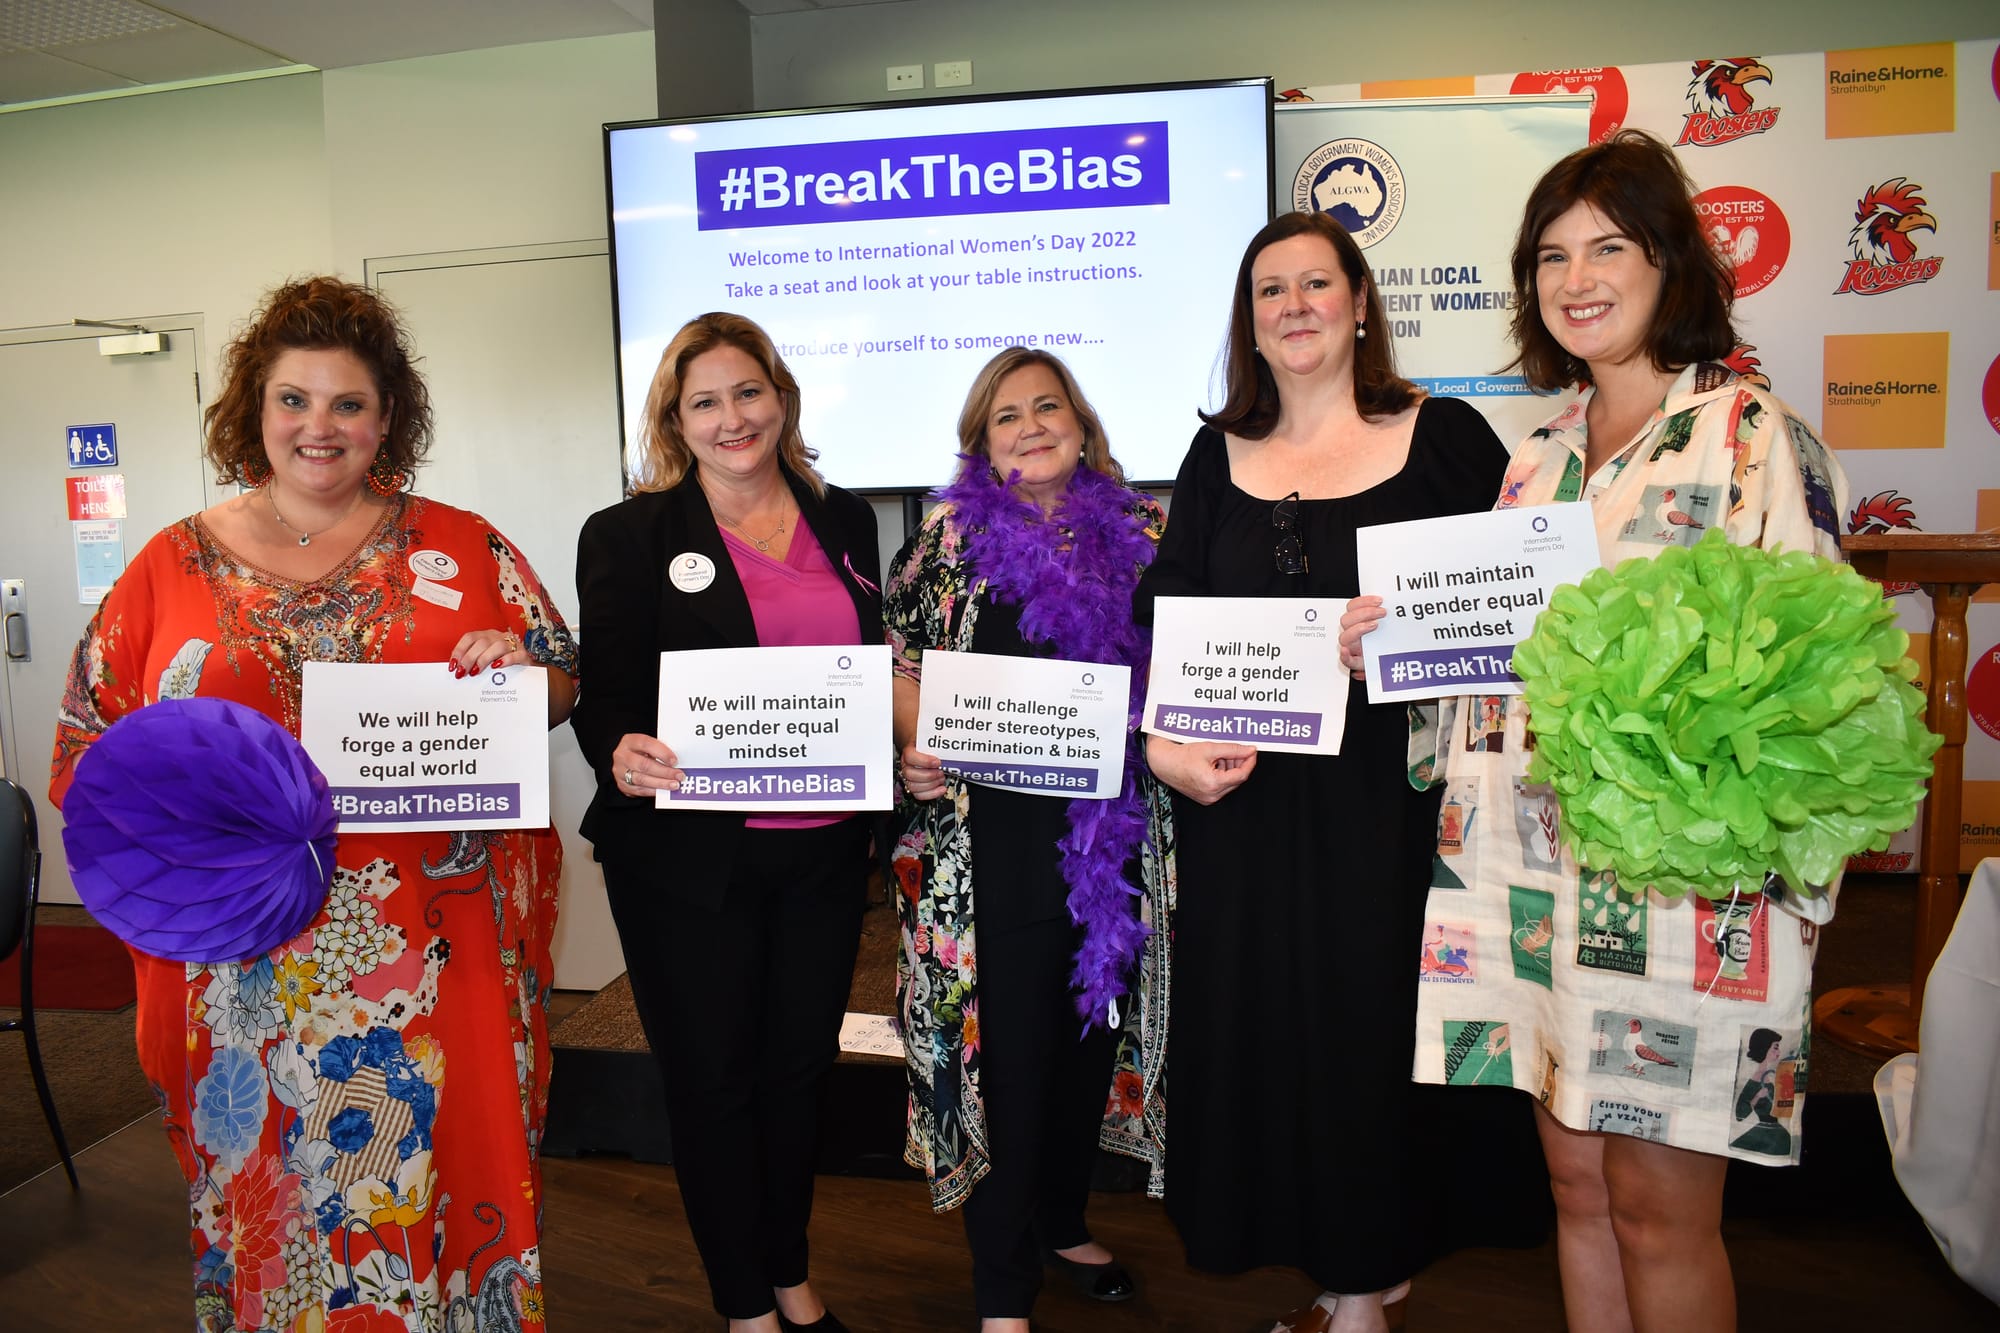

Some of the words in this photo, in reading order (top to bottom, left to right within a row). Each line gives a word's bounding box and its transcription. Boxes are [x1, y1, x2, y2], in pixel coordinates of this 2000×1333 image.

[1564, 76, 1581, 84] EST
[1583, 75, 1603, 83] 1879
[1830, 83, 1886, 95] Strathalbyn
[1672, 106, 1781, 147] Roosters
[1308, 143, 1364, 172] GOVERNMENT
[1364, 146, 1398, 181] WOMEN'S
[719, 146, 1143, 212] #BreakTheBias
[1297, 170, 1313, 196] LOCAL
[1329, 185, 1370, 196] ALGWA
[1374, 181, 1401, 234] ASSOCIATION
[1725, 216, 1742, 224] EST
[1744, 215, 1765, 223] 1879
[728, 250, 809, 267] Welcome
[815, 248, 833, 263] to
[838, 239, 955, 261] International
[1051, 234, 1086, 253] Day
[1091, 231, 1137, 249] 2022
[725, 281, 763, 298] Take
[769, 284, 778, 296] a
[783, 279, 820, 295] seat
[825, 276, 857, 293] and
[863, 273, 901, 290] look
[907, 273, 924, 289] at
[929, 274, 970, 291] your
[976, 268, 1022, 285] table
[1028, 264, 1143, 283] instructions.
[1421, 266, 1482, 286] LOCAL
[1735, 280, 1765, 296] OTBALL
[1762, 264, 1780, 282] CLUB
[1832, 256, 1944, 295] Roosters
[853, 334, 925, 358] yourself
[930, 336, 949, 351] to
[954, 333, 1038, 350] someone
[1434, 382, 1470, 393] Local
[1828, 397, 1881, 407] Strathalbyn
[1523, 535, 1562, 545] International
[1523, 544, 1552, 554] Women's
[1552, 543, 1565, 551] Day
[1396, 575, 1402, 591] I
[1407, 572, 1440, 590] will
[1445, 562, 1535, 587] maintain
[1395, 605, 1406, 618] a
[1412, 597, 1481, 620] gender
[1487, 588, 1544, 612] equal
[1433, 619, 1514, 640] mindset
[1206, 641, 1211, 655] I
[1215, 642, 1242, 656] will
[1247, 643, 1281, 660] help
[1181, 662, 1223, 680] forge
[1228, 668, 1237, 678] a
[1241, 664, 1300, 682] gender
[1391, 656, 1515, 683] #BreakThe
[852, 680, 864, 688] Day
[1194, 686, 1237, 703] equal
[1242, 688, 1289, 703] world
[506, 696, 519, 704] Day
[689, 696, 717, 711] We
[724, 695, 756, 711] will
[763, 694, 846, 711] maintain
[954, 694, 959, 708] I
[964, 696, 991, 711] will
[997, 698, 1079, 721] challenge
[358, 712, 390, 728] We
[397, 711, 429, 727] will
[436, 710, 479, 729] help
[695, 724, 706, 736] a
[712, 719, 781, 740] gender
[786, 718, 839, 738] equal
[934, 716, 993, 733] gender
[997, 721, 1101, 743] stereotypes,
[1163, 711, 1312, 738] #BreakTheBias
[341, 736, 395, 757] forge
[402, 740, 413, 753] a
[419, 734, 490, 755] gender
[729, 743, 808, 759] mindset
[927, 735, 1044, 756] discrimination
[1049, 744, 1061, 757] &
[1066, 745, 1102, 760] bias
[359, 761, 415, 782] equal
[421, 759, 478, 777] world
[680, 774, 856, 795] #BreakTheBias
[1741, 987, 1766, 997] VARY
[1617, 1113, 1643, 1124] VZAL
[1634, 1106, 1662, 1119] VODU
